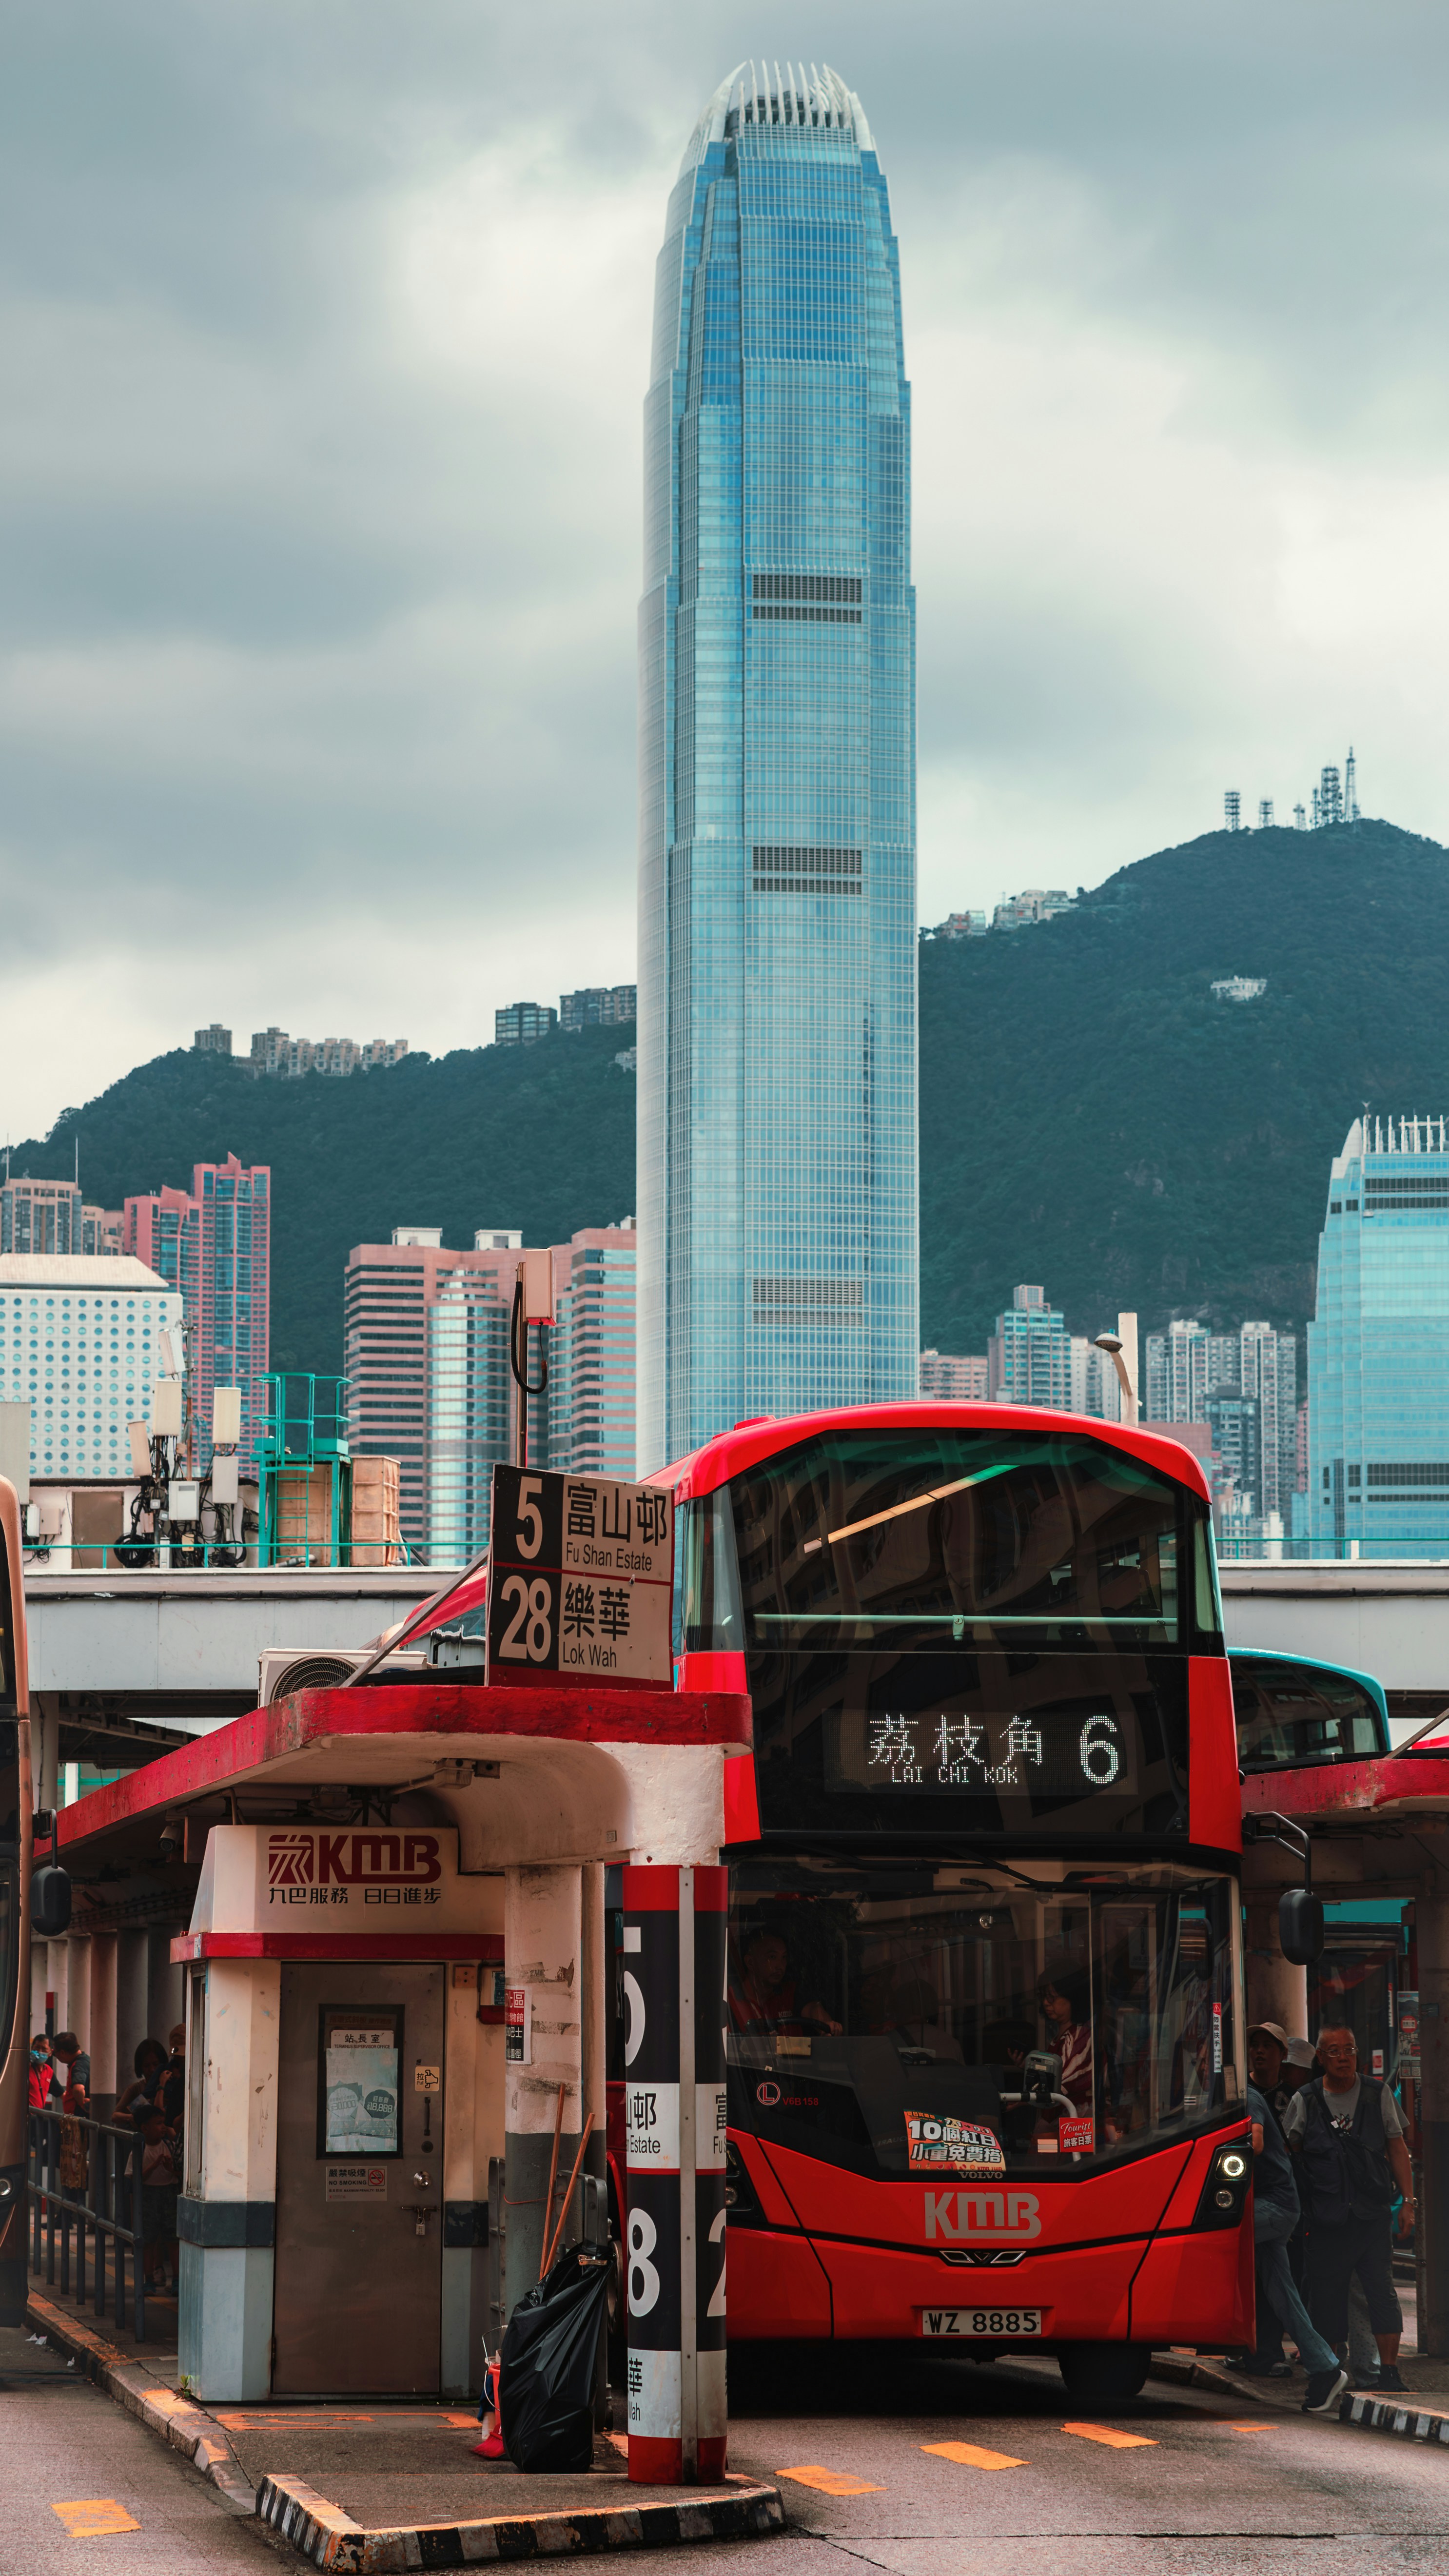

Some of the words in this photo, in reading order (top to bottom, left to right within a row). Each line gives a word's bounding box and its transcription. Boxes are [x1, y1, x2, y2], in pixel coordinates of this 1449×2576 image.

[516, 1476, 543, 1559] 5
[567, 1483, 667, 1546] 富山邨
[567, 1542, 579, 1562] Fu
[583, 1544, 612, 1567] Shan
[616, 1548, 652, 1572] Estate
[499, 1575, 551, 1662] 28
[563, 1582, 630, 1642] 樂華
[563, 1642, 585, 1663] Lok
[588, 1644, 617, 1668] Wah
[868, 1713, 1042, 1766] 荔枝角
[1080, 1716, 1118, 1783] 6
[892, 1766, 923, 1783] LAI
[939, 1766, 969, 1783] CHI
[984, 1766, 1018, 1783] KOK
[319, 1835, 442, 1884] KMB
[269, 1888, 348, 1904] 九巴服務
[365, 1888, 441, 1904] 日日進步
[345, 2034, 380, 2043] 站長室
[763, 2085, 775, 2101] L
[367, 2102, 393, 2113] $18,888
[909, 2120, 997, 2147] 10個紅日
[944, 2118, 962, 2127] 7.1
[973, 2125, 990, 2134] 9.1
[1061, 2122, 1091, 2135] Tourist
[630, 2135, 661, 2154] Estate
[713, 2136, 723, 2154] Fu
[911, 2143, 1001, 2163] 小童免費搭
[1063, 2135, 1092, 2148] 旅客日票
[924, 2192, 1042, 2239] KMB
[928, 2313, 959, 2333] WZ
[973, 2312, 1037, 2333] 8885
[629, 2357, 643, 2397] 華
